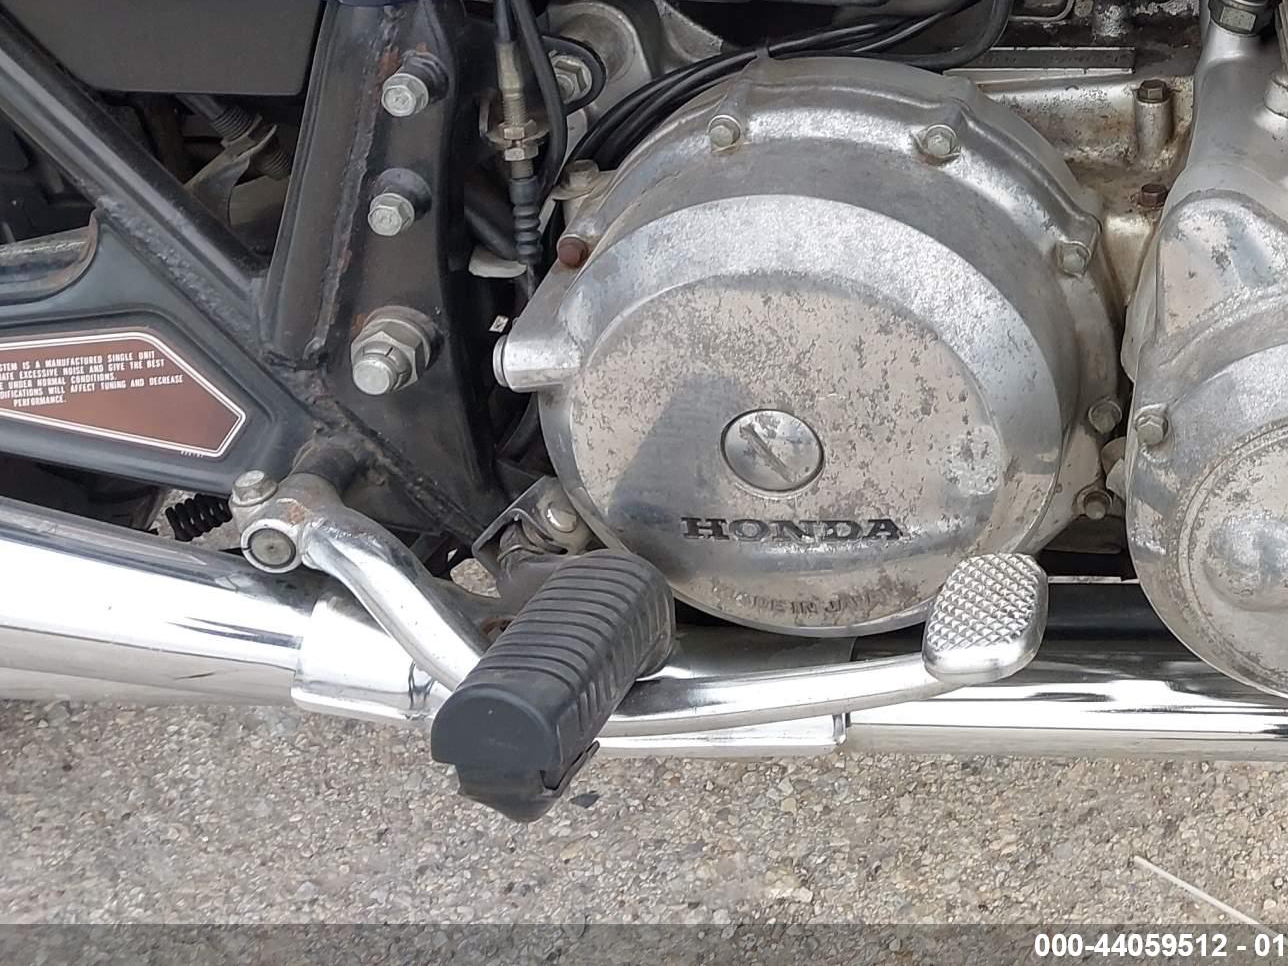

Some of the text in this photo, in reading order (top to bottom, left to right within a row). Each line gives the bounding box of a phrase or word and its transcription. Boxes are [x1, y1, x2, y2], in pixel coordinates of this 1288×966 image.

[19, 368, 58, 380] EXCESSIVE
[63, 365, 84, 376] NOISE
[88, 364, 104, 374] AND
[108, 362, 125, 372] GIVE
[130, 360, 143, 370] THE
[146, 358, 165, 368] BEST
[22, 361, 30, 370] IS
[35, 360, 41, 369] A
[45, 355, 103, 368] MANUFACTURED
[107, 352, 133, 363] SINGLE
[138, 350, 155, 360] UNIT
[8, 379, 33, 390] UNDER
[37, 377, 66, 387] NORMAL
[70, 372, 118, 384] CONDITIONS.
[48, 386, 66, 395] WILL
[70, 382, 96, 393] AFFECT
[101, 379, 126, 390] TUNING
[130, 378, 145, 388] AND
[149, 374, 184, 386] DECREASE
[13, 394, 67, 407] PERFORMANCE.
[680, 516, 905, 543] HONDA
